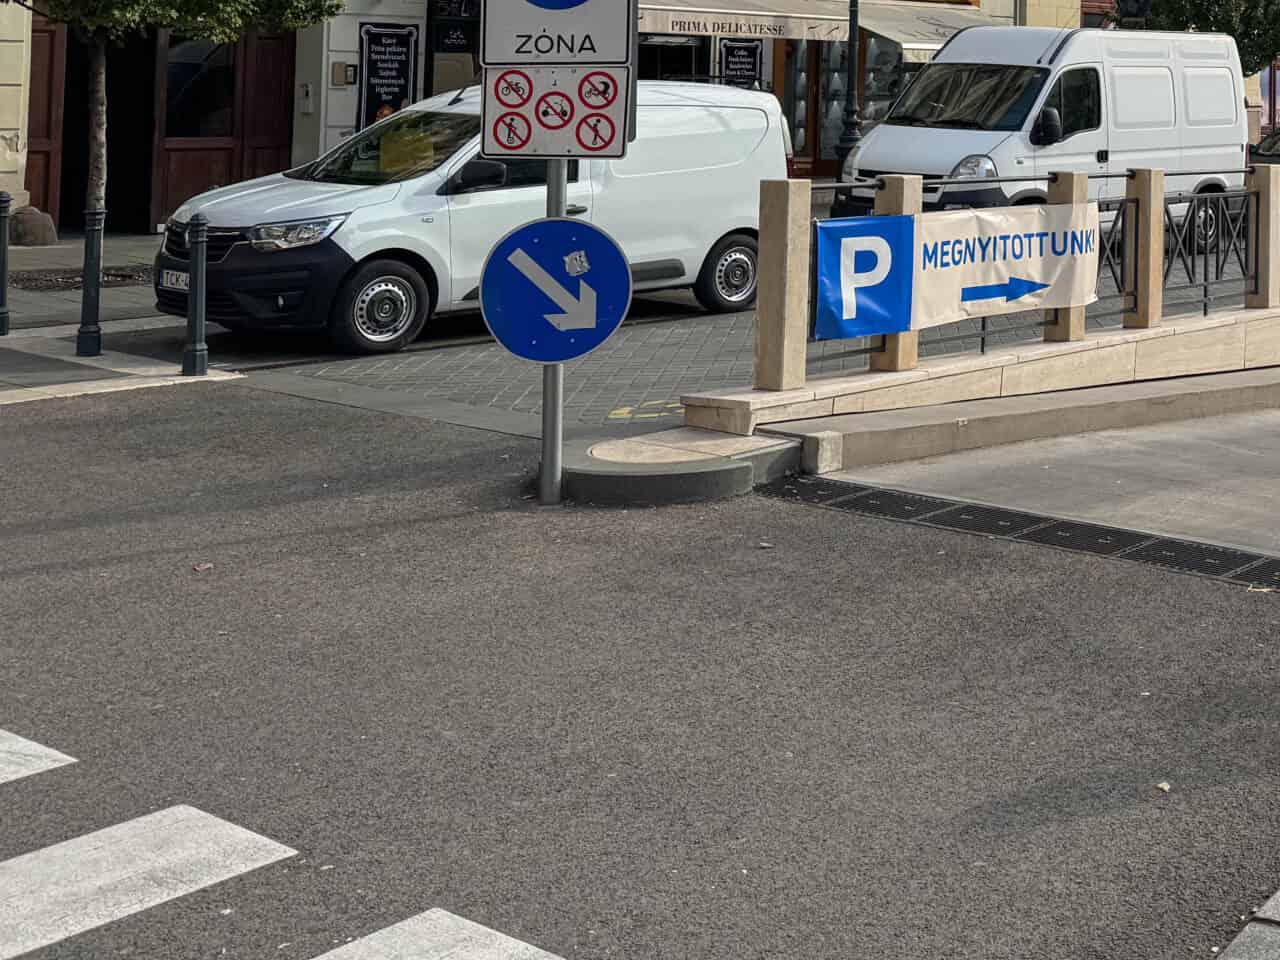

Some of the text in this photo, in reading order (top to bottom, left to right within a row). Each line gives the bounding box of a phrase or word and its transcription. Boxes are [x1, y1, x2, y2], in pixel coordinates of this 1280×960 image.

[514, 27, 597, 54] ZÓNA
[671, 20, 785, 36] PRIMA DELICATESSE
[922, 229, 1095, 271] MEGNYITOTTUNK!
[840, 236, 892, 320] P
